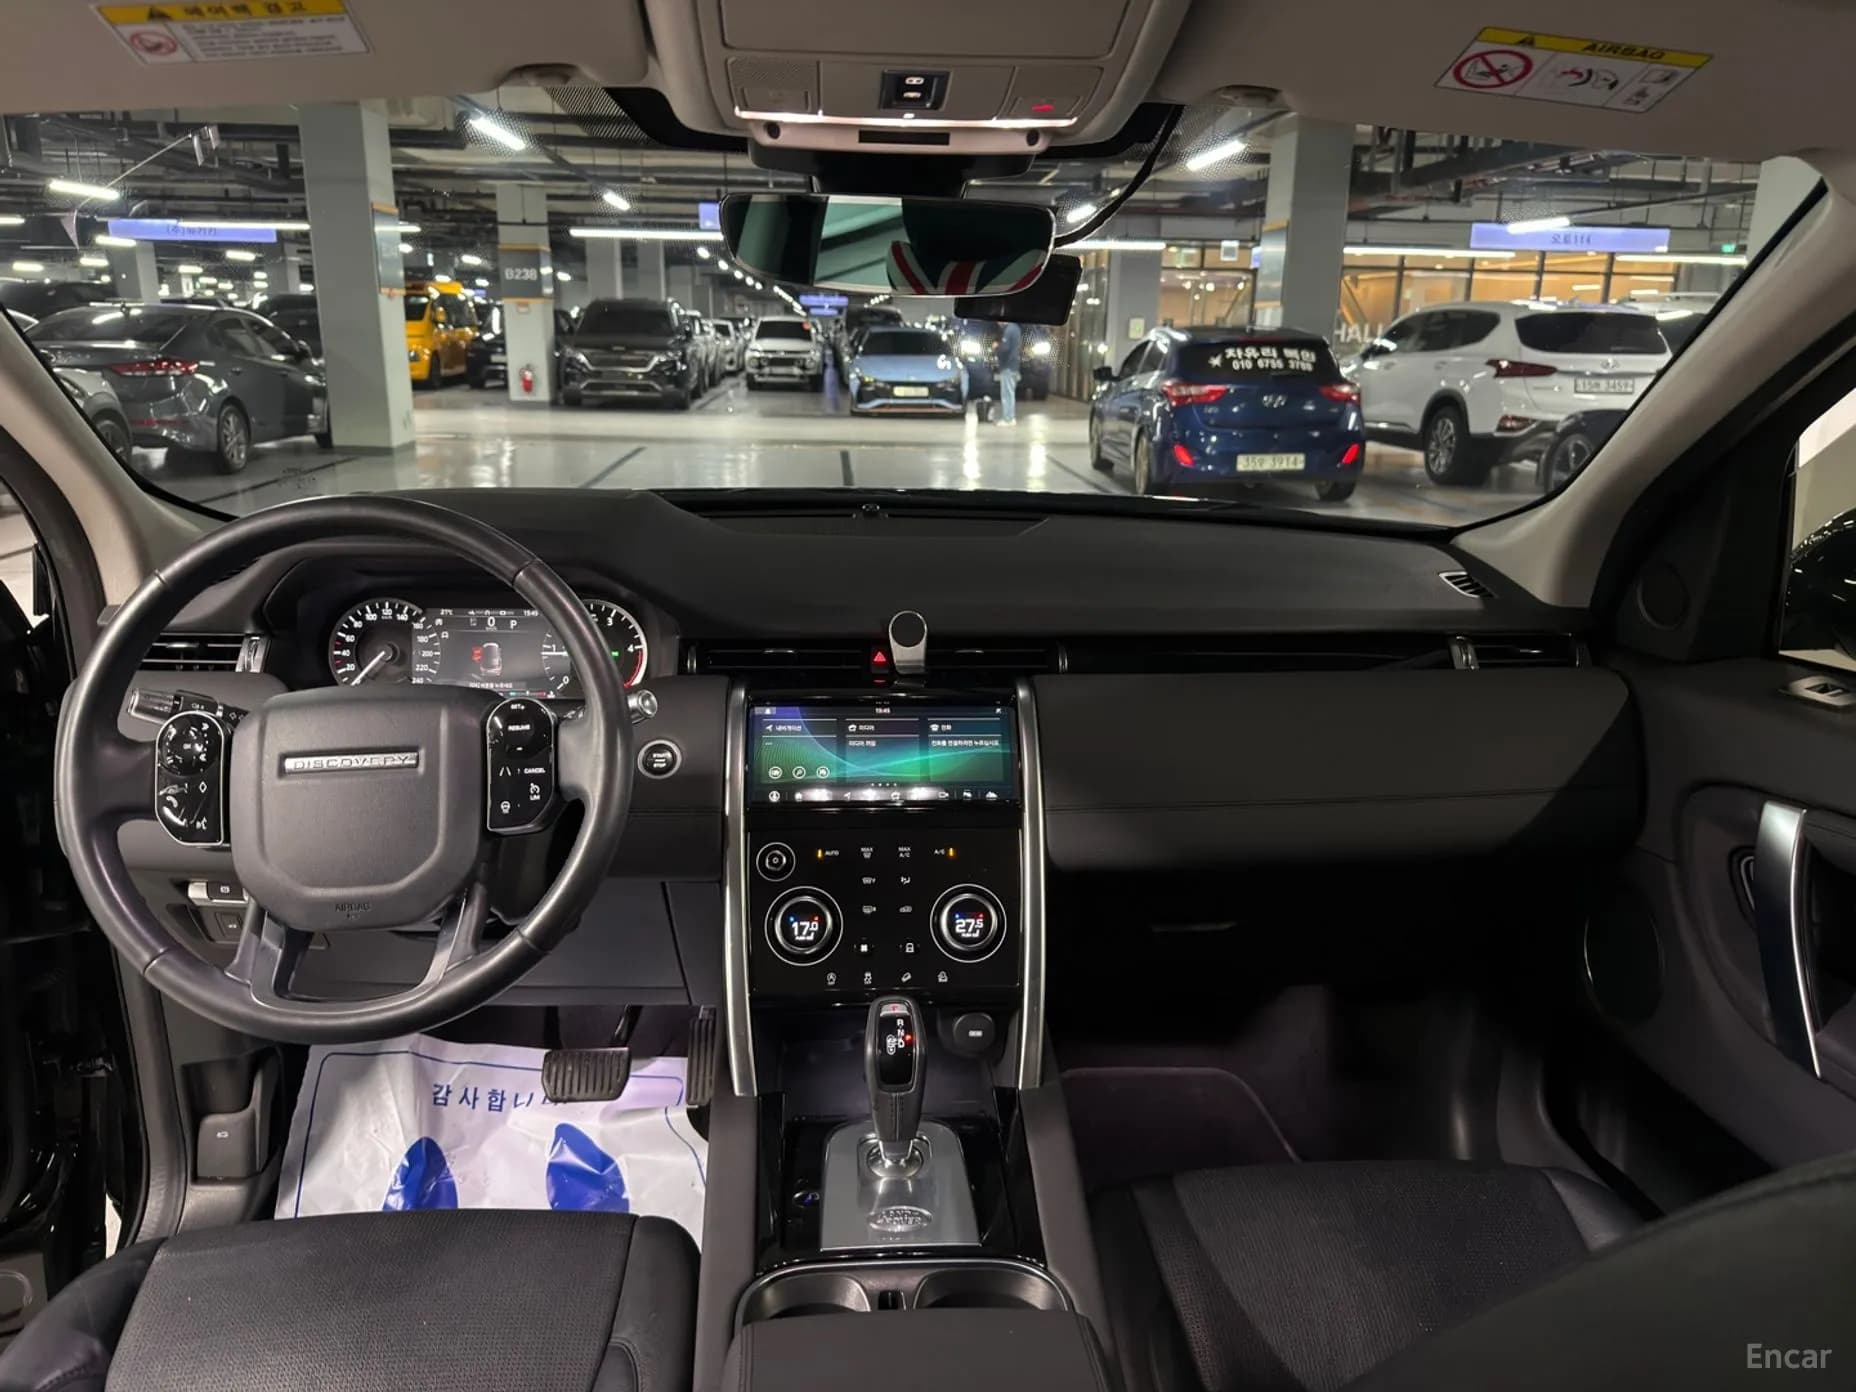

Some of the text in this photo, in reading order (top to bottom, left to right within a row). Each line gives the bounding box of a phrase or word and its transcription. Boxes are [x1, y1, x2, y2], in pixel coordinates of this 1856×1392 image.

[1583, 43, 1666, 59] AIRBAG
[487, 616, 495, 627] 0
[510, 620, 517, 629] P
[607, 618, 614, 626] 3
[627, 644, 634, 652] 4
[562, 676, 570, 685] 0
[294, 755, 410, 770] DISCOVERY
